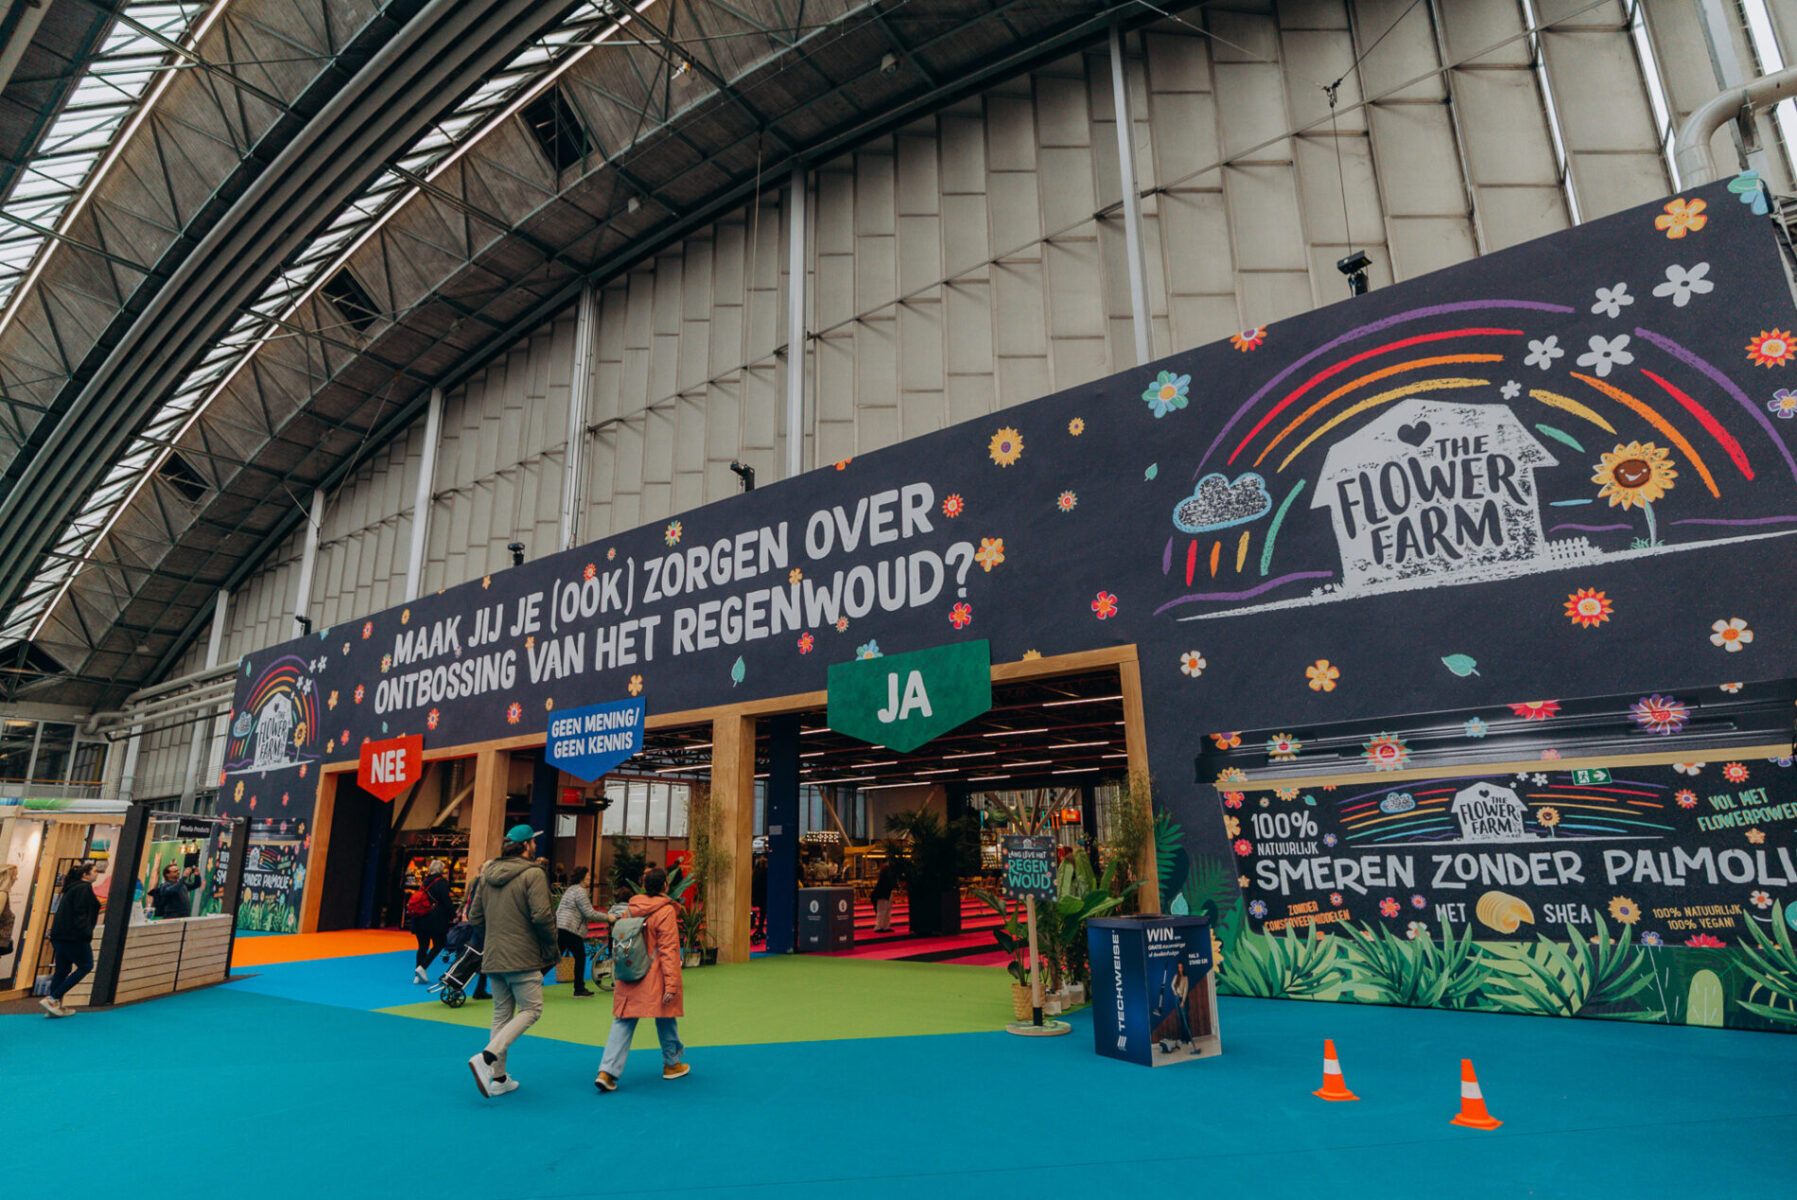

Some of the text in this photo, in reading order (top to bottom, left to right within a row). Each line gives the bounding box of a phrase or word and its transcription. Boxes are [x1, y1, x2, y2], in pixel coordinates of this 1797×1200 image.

[1434, 434, 1489, 460] THE
[1337, 453, 1528, 540] FLOWER
[1371, 499, 1504, 565] FARM
[392, 482, 934, 668] MAAK JIJ JE (OOK) ZORGEN OVER
[374, 541, 976, 714] ONTBOSSING VAN HET REGENWOUD?
[877, 670, 933, 723] JA
[551, 707, 640, 738] GEEN MENING/
[554, 731, 633, 759] GEEN KENNIS
[371, 748, 407, 784] NEE
[1708, 787, 1769, 811] VOL MET
[1251, 810, 1318, 840] 100%
[1460, 801, 1520, 825] FLOWER
[1472, 818, 1513, 836] FARM
[1257, 841, 1319, 856] NATUURLIJK
[1008, 858, 1048, 875] REGEN
[1255, 855, 1416, 896] SMEREN
[1431, 850, 1586, 889] ZONDER
[1008, 872, 1051, 889] WOUD
[1435, 902, 1592, 924] MET SHEA
[1652, 904, 1743, 919] 100% NATUURLIJK
[1667, 919, 1697, 931] 100%
[1146, 927, 1174, 943] WIN
[1112, 933, 1126, 1032] TECHWEISE
